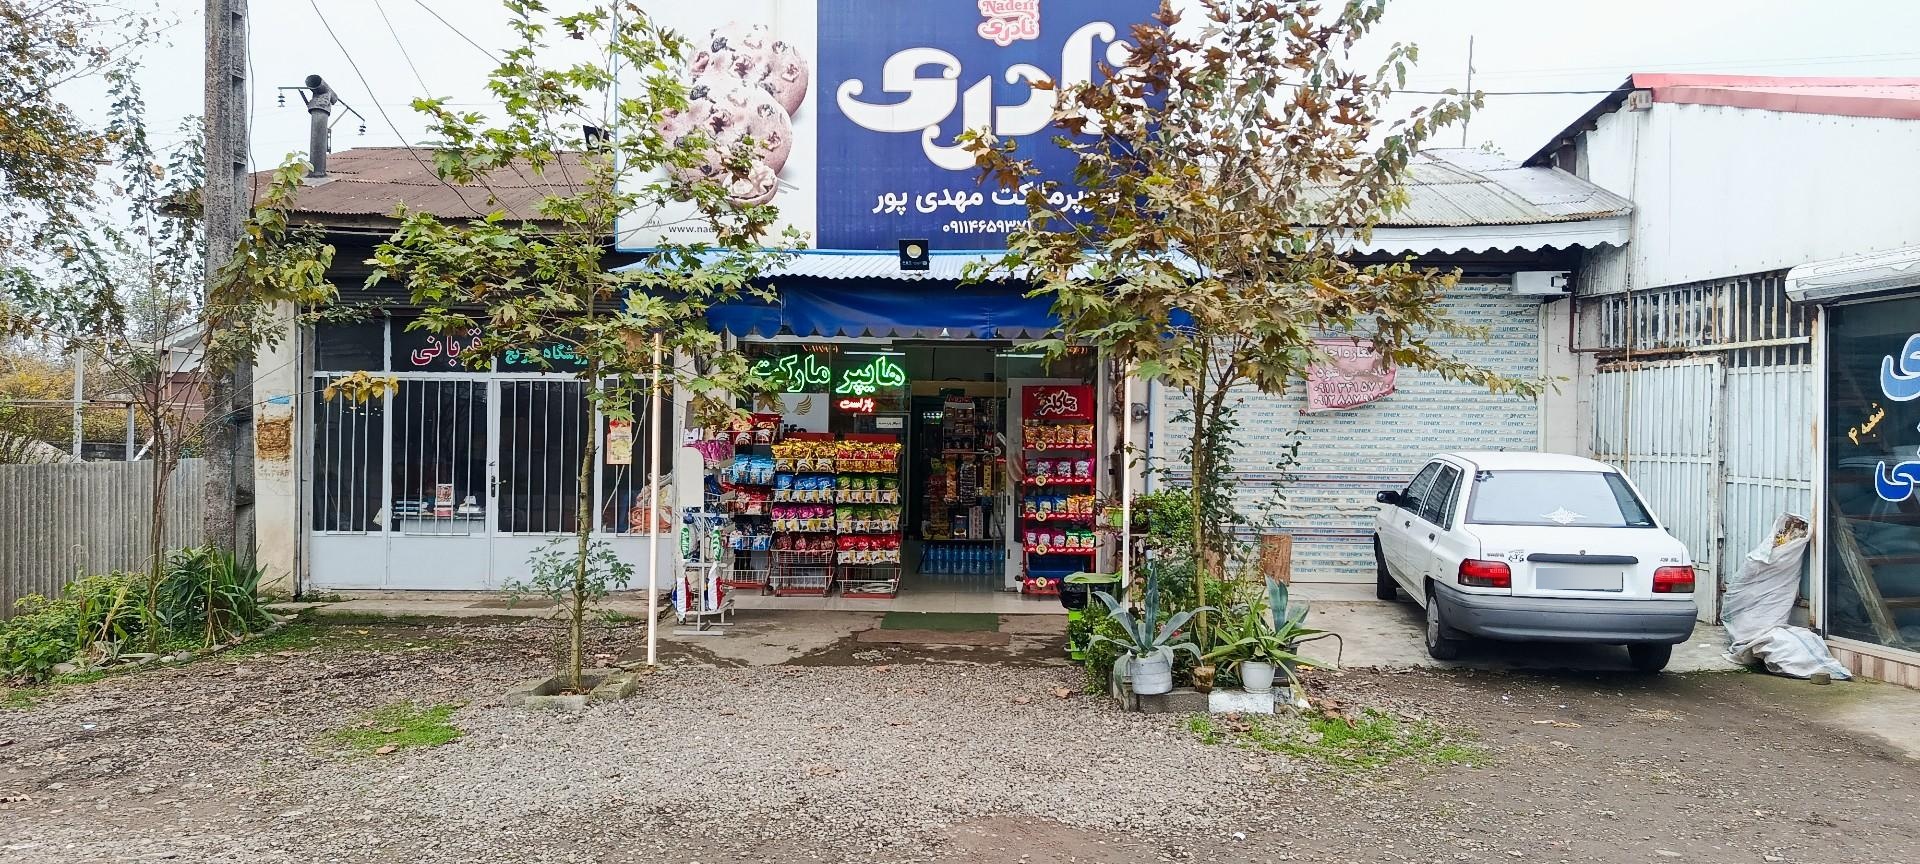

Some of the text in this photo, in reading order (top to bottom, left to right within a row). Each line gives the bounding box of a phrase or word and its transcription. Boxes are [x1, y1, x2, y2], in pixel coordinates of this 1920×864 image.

[981, 0, 1036, 15] Naderi
[981, 17, 1036, 42] نادری
[872, 191, 908, 216] پور
[916, 189, 984, 214] مهدی
[410, 327, 484, 367] قبانی
[749, 353, 906, 396] هایپر مارکت
